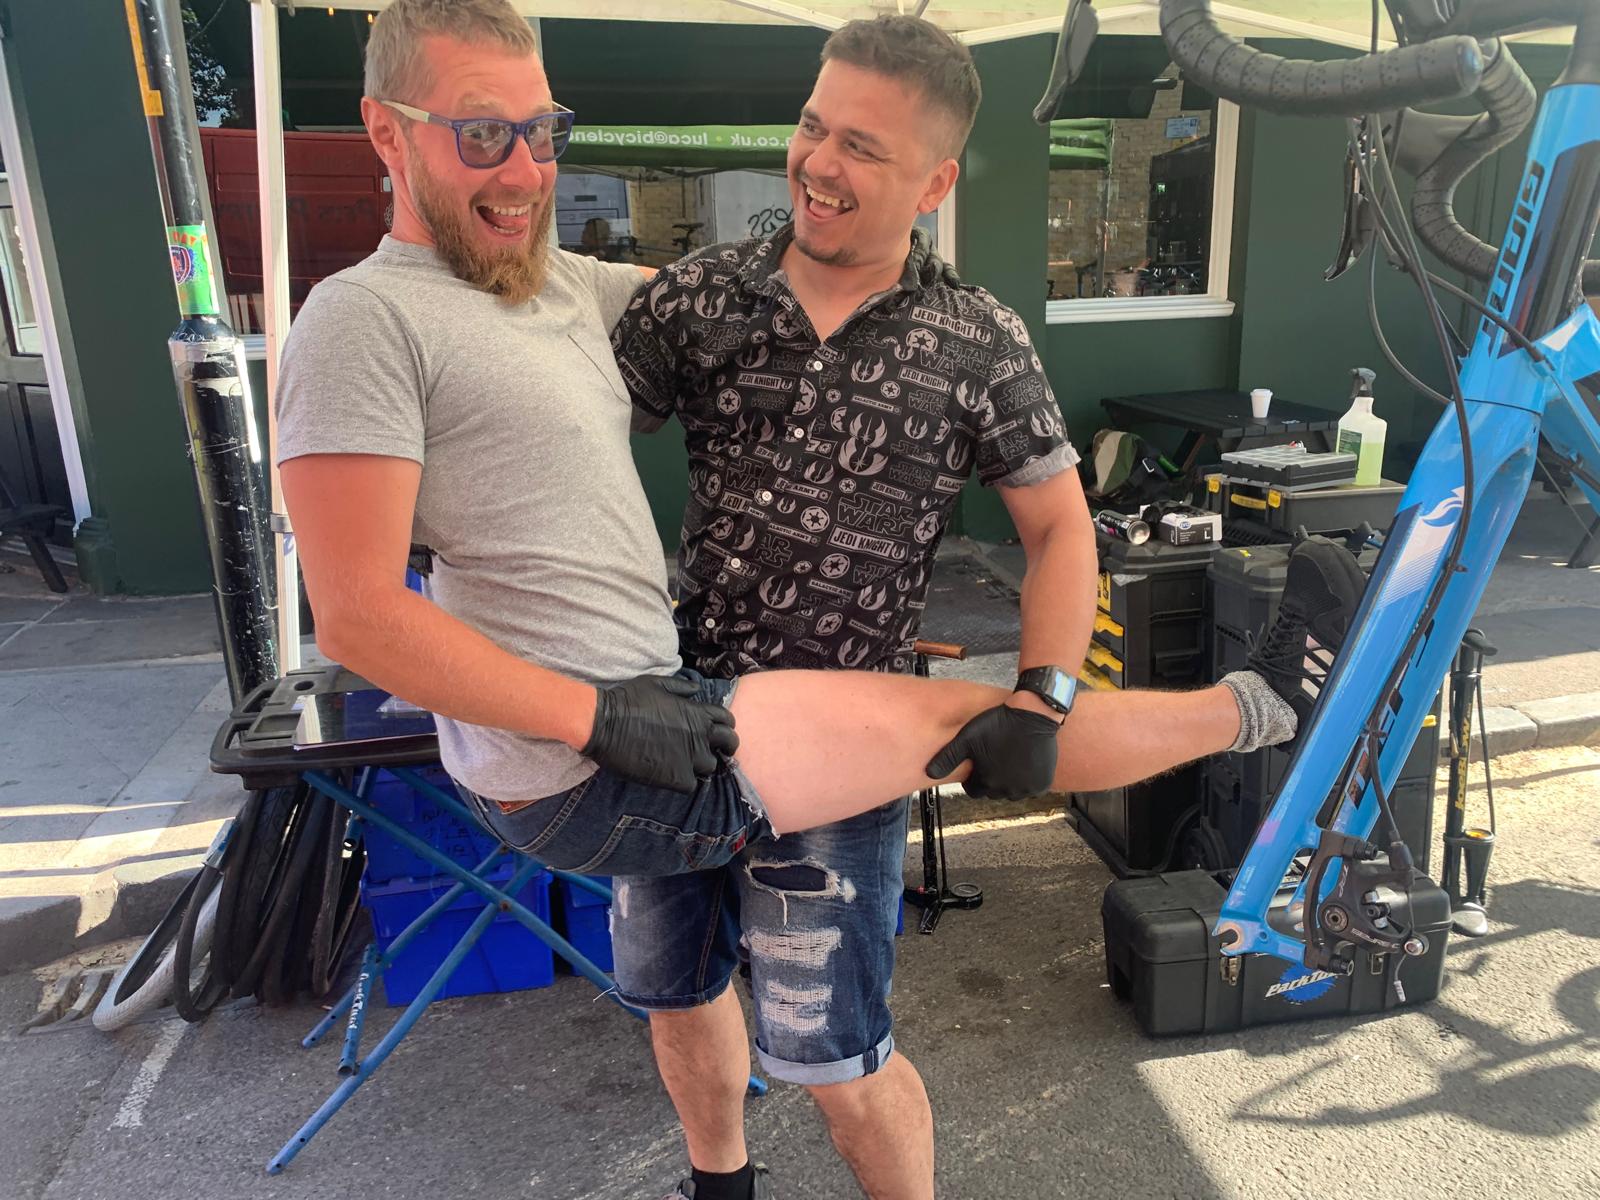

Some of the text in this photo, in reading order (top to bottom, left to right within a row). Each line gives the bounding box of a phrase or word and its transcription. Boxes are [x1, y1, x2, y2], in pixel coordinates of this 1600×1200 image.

[913, 308, 975, 337] JEDI KNIGHT
[919, 350, 957, 377] WA
[990, 361, 1013, 382] IGHT
[901, 368, 949, 392] JEDI KNIGHT
[838, 502, 917, 537] WARS
[839, 493, 917, 521] STAR
[769, 523, 792, 535] ALACTIC
[1203, 530, 1212, 540] L
[834, 531, 893, 560] JEDI KNIGHT
[1265, 968, 1342, 998] ParkTo
